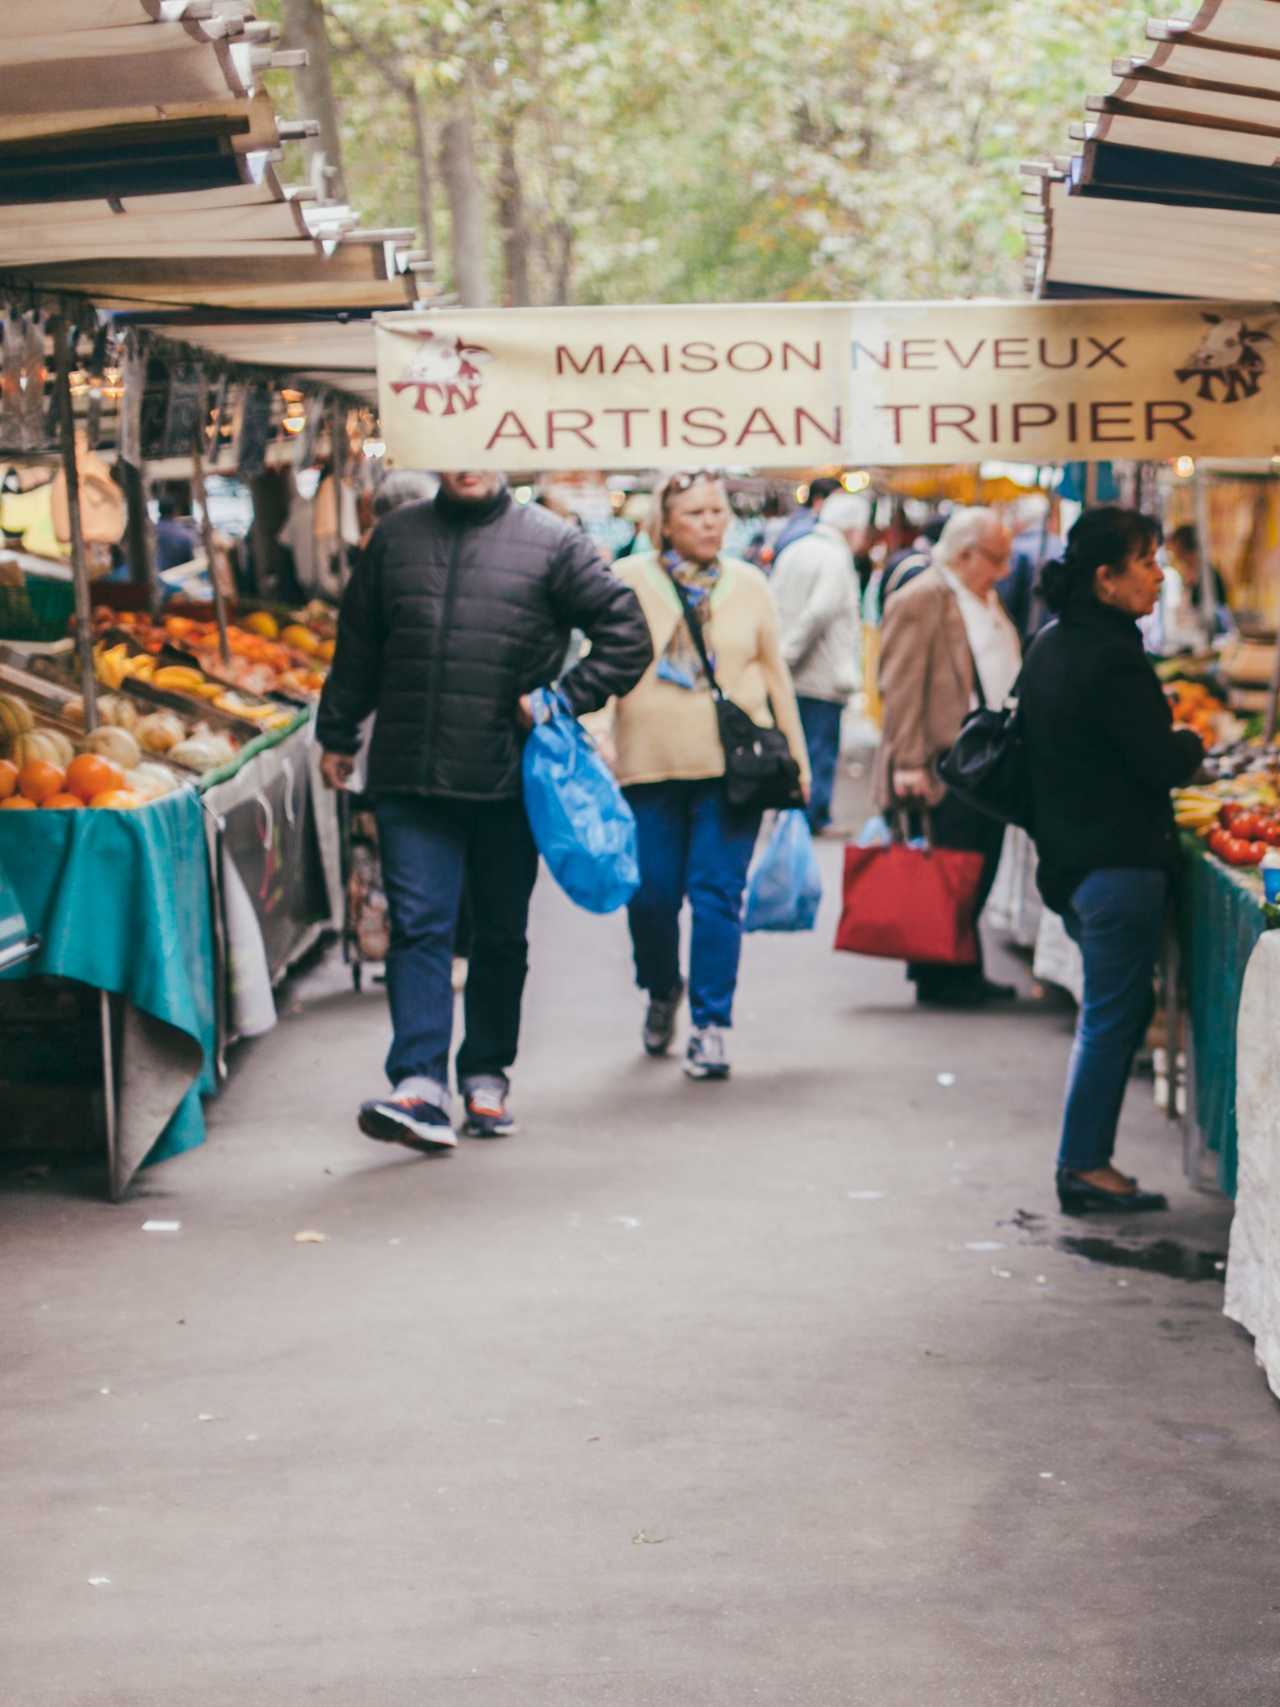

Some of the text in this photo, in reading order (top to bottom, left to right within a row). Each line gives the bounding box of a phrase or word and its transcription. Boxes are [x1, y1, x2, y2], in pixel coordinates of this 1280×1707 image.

[555, 336, 1129, 375] MAISON NEVEUX
[485, 400, 1197, 450] ARTISAN TRIPIER
